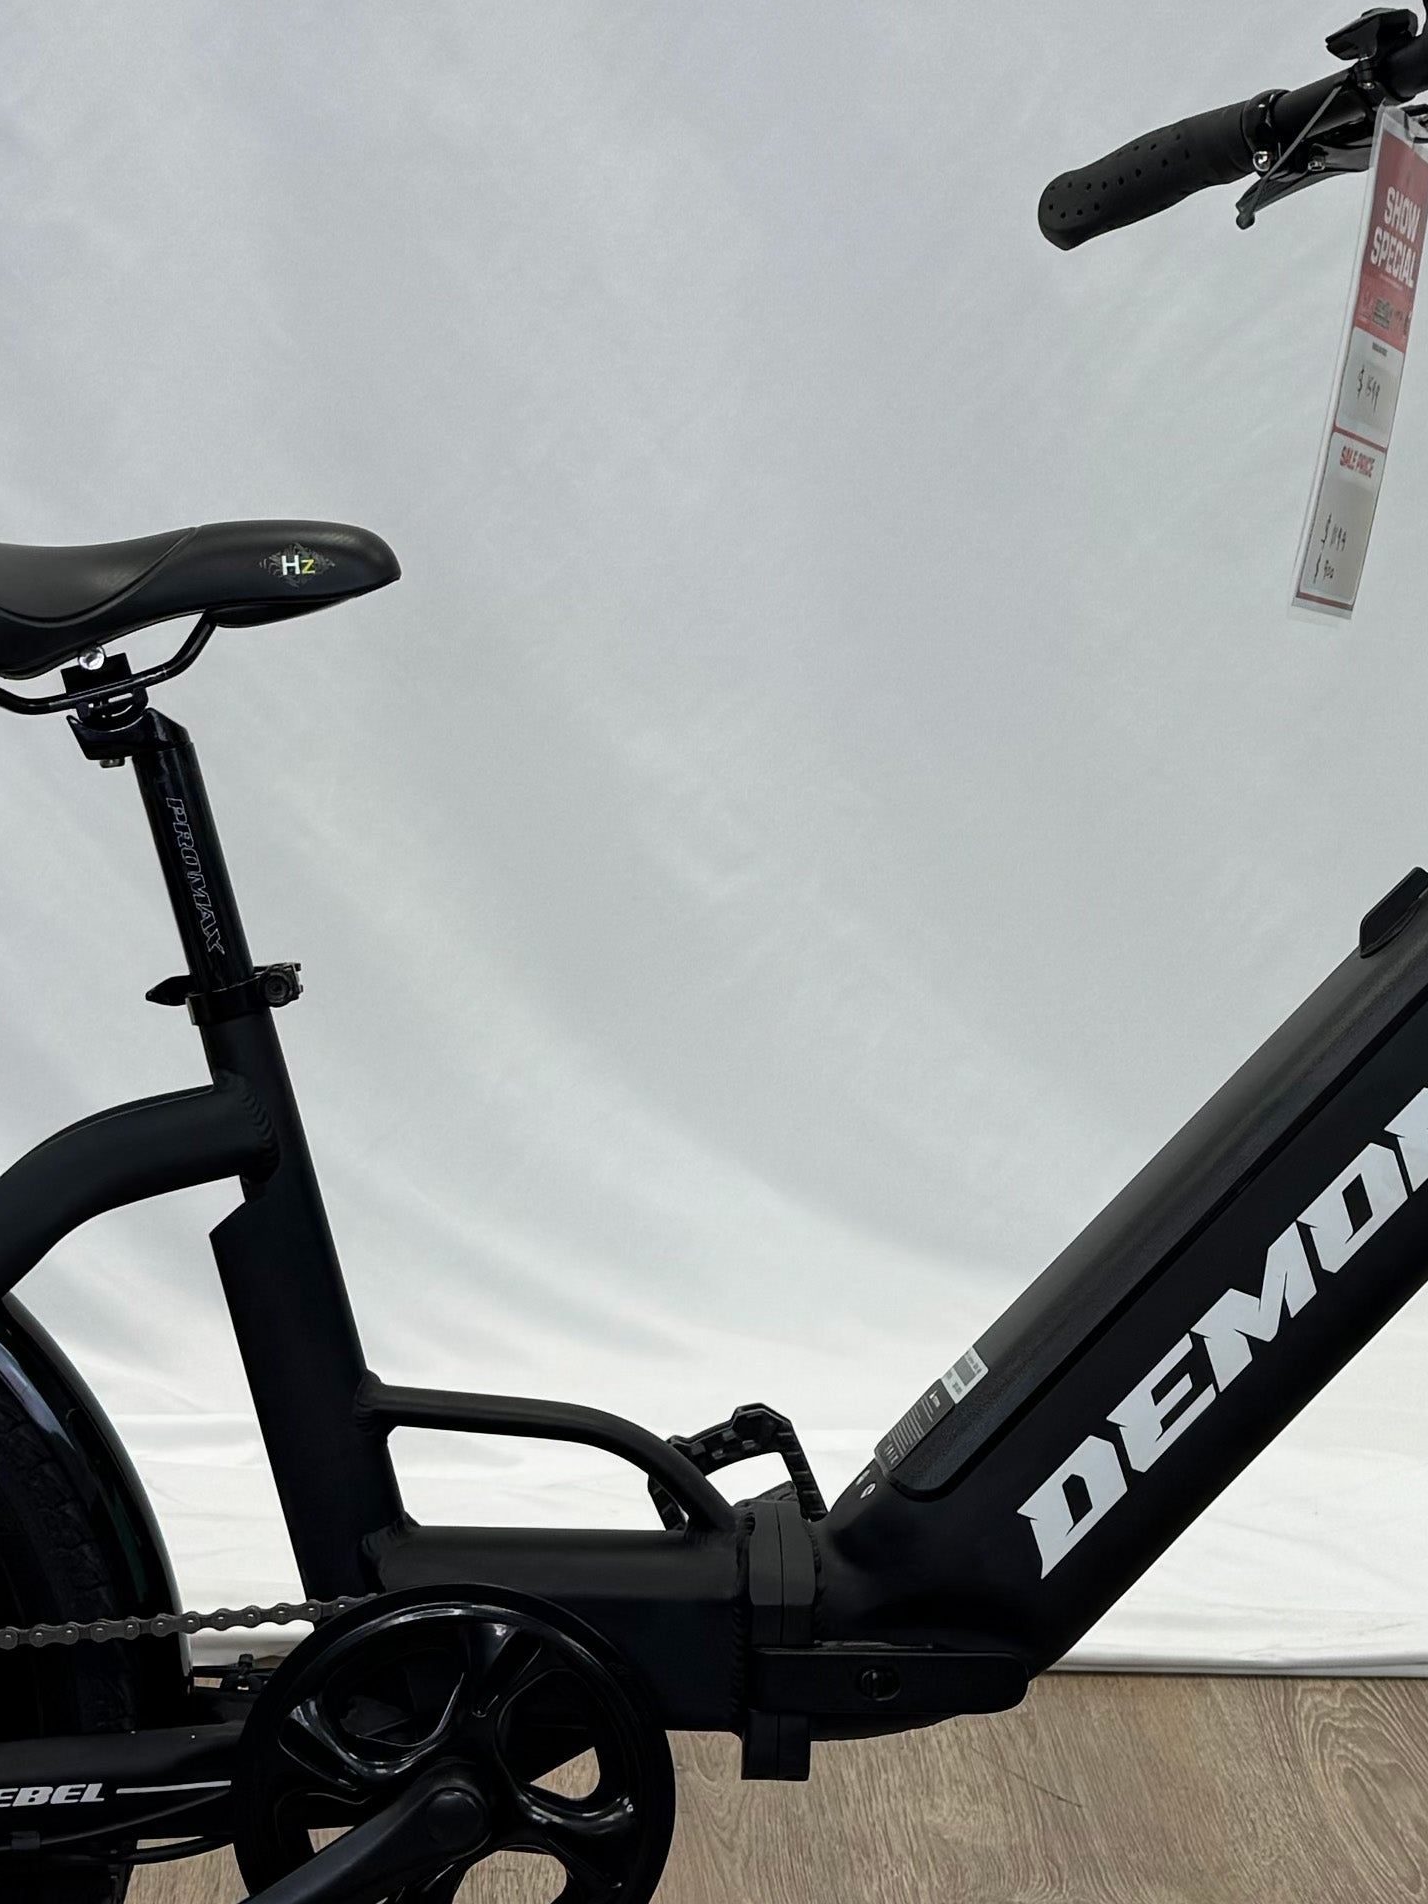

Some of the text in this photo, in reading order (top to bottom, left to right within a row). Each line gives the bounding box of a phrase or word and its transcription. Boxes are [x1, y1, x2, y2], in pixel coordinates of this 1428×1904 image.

[1384, 186, 1421, 242] SHOW
[1370, 227, 1417, 289] SPECIAL
[1340, 445, 1358, 471] SALE
[167, 797, 225, 955] PROMAX
